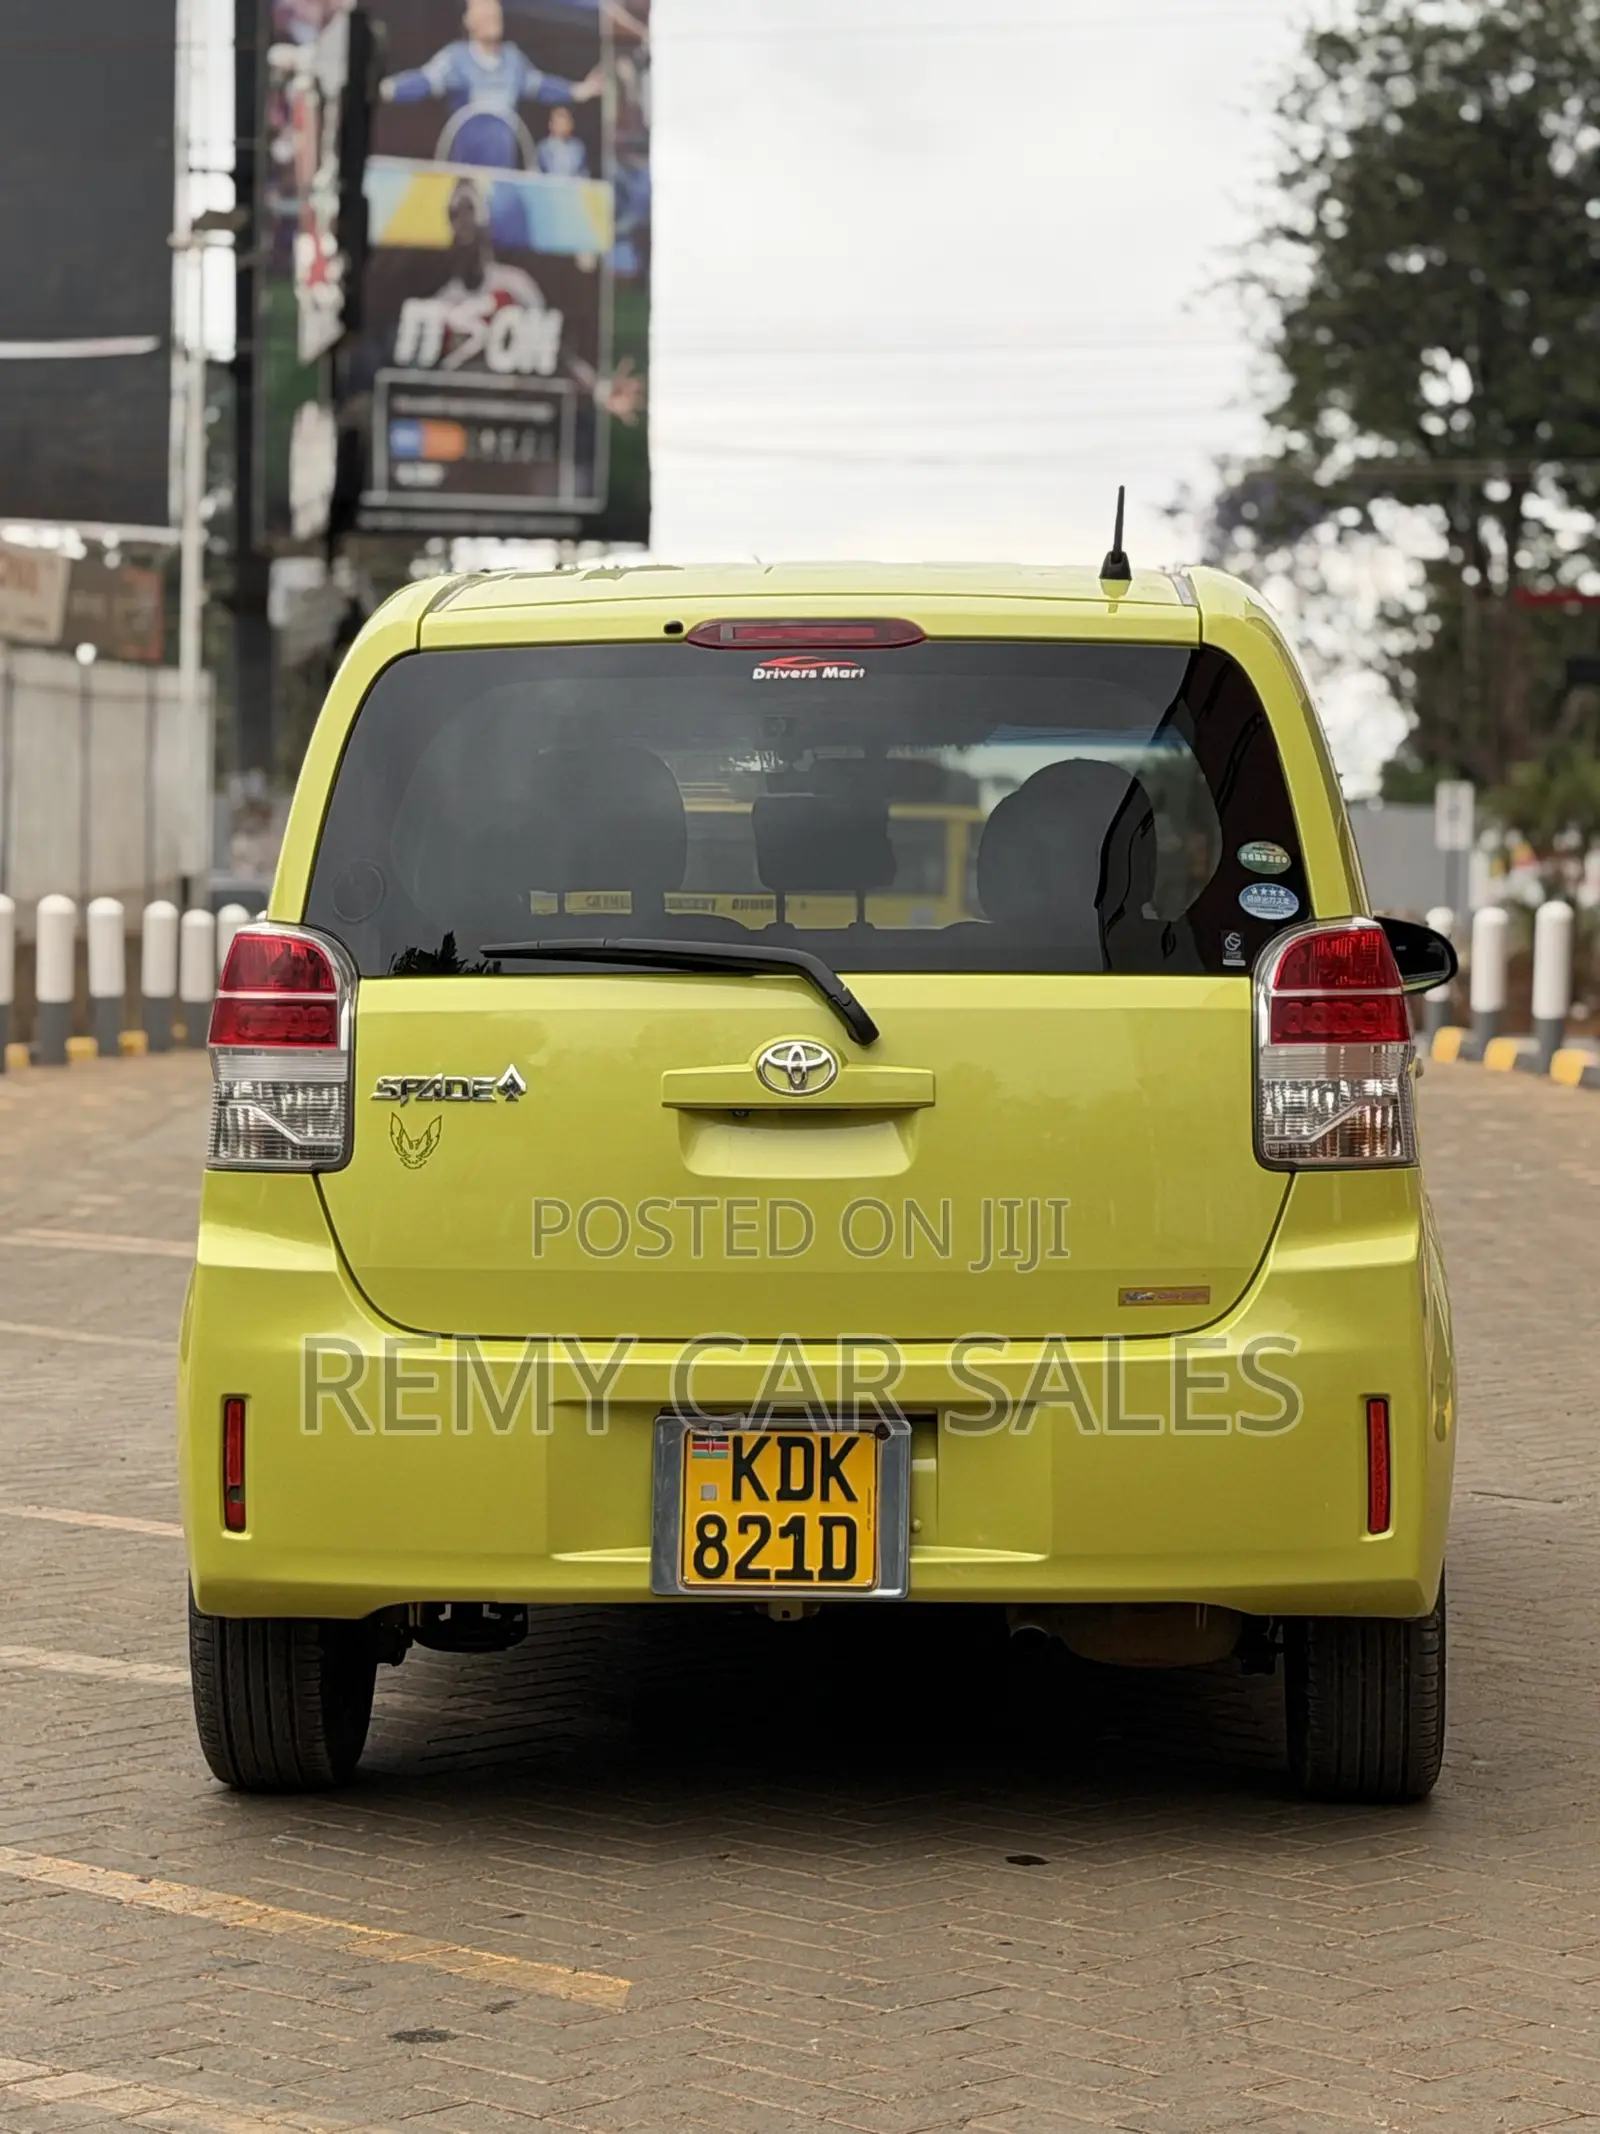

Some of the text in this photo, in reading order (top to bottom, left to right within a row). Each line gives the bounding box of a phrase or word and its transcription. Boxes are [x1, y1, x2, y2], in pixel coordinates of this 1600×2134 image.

[752, 667, 865, 680] Drivers Mart
[371, 1073, 497, 1107] SPADE
[731, 1435, 860, 1502] KDK
[693, 1513, 858, 1581] 821D
